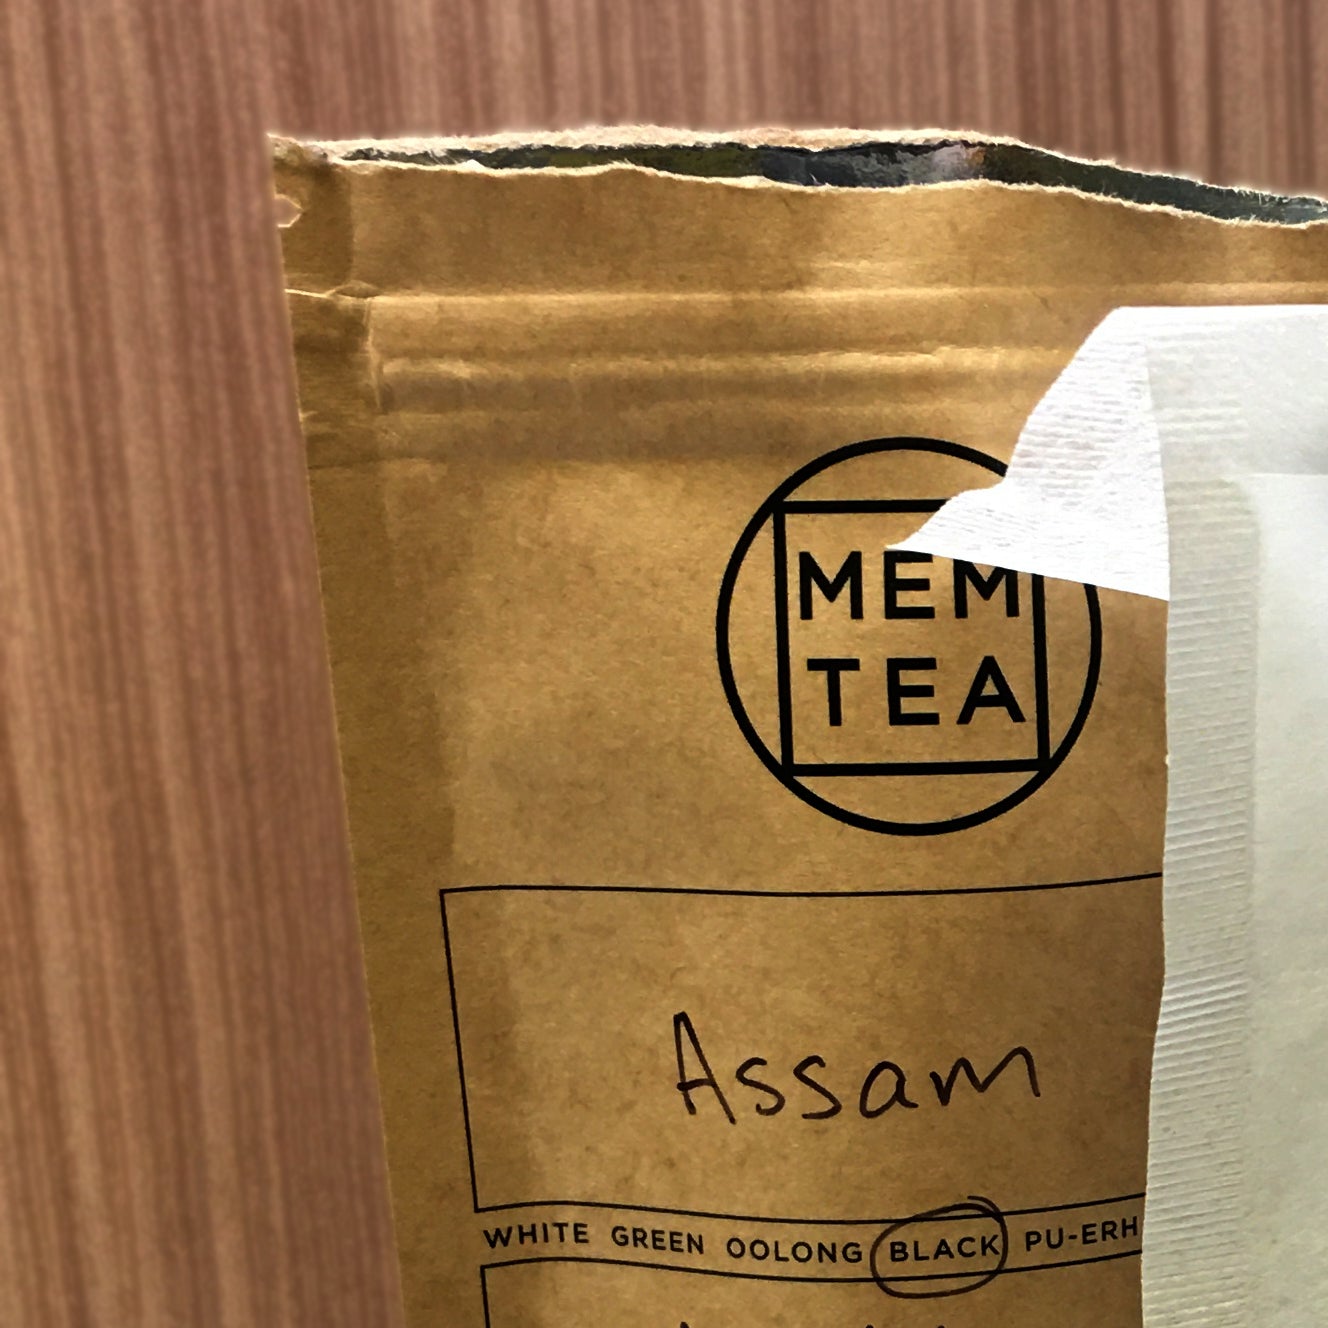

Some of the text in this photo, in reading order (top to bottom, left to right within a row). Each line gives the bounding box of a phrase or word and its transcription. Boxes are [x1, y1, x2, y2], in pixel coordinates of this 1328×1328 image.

[799, 549, 1020, 620] MEM
[806, 655, 1027, 727] TEA
[672, 1011, 1042, 1125] Assam
[483, 1216, 1138, 1265] WHITE GREEN OOLONG BLACK PU-ERH
